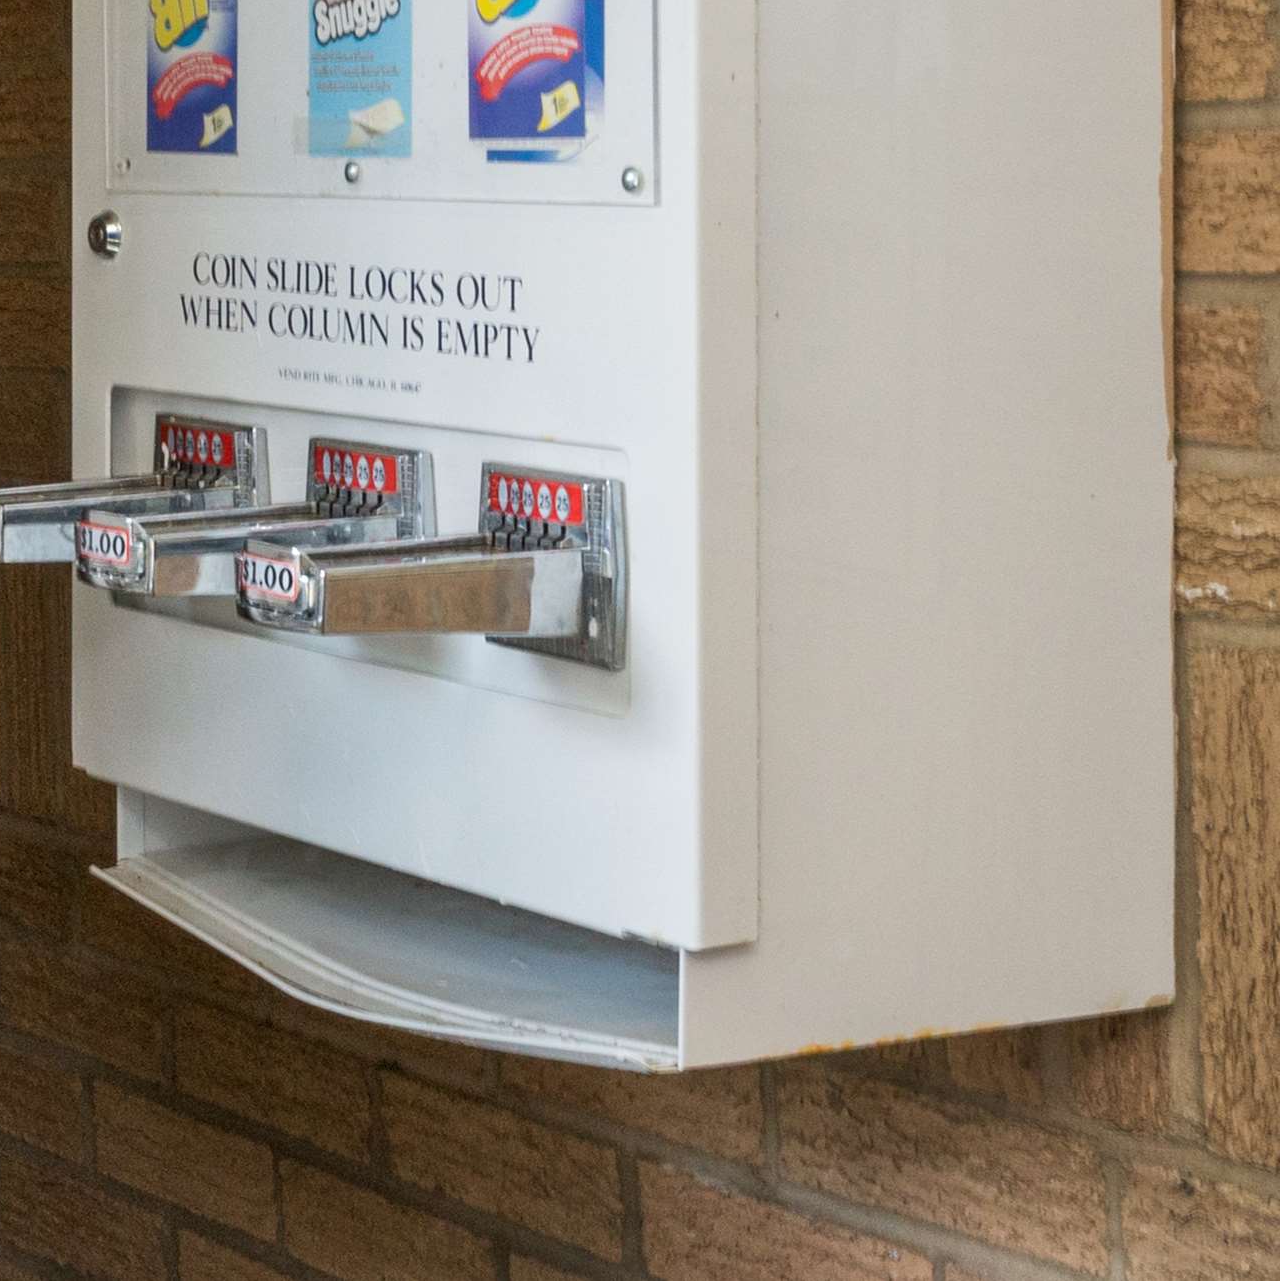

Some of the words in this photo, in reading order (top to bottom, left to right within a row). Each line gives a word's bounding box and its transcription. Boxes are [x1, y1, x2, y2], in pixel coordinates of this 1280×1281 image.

[192, 250, 258, 292] COIN
[266, 256, 339, 300] SLIDE
[349, 263, 445, 308] LOCKS
[456, 271, 524, 314] OUT
[180, 293, 258, 334] WHEN
[267, 301, 390, 350] COLUMN
[401, 315, 425, 354] IS
[436, 318, 541, 364] EMPTY
[79, 525, 127, 559] $1.00
[241, 556, 294, 594] $1.00
